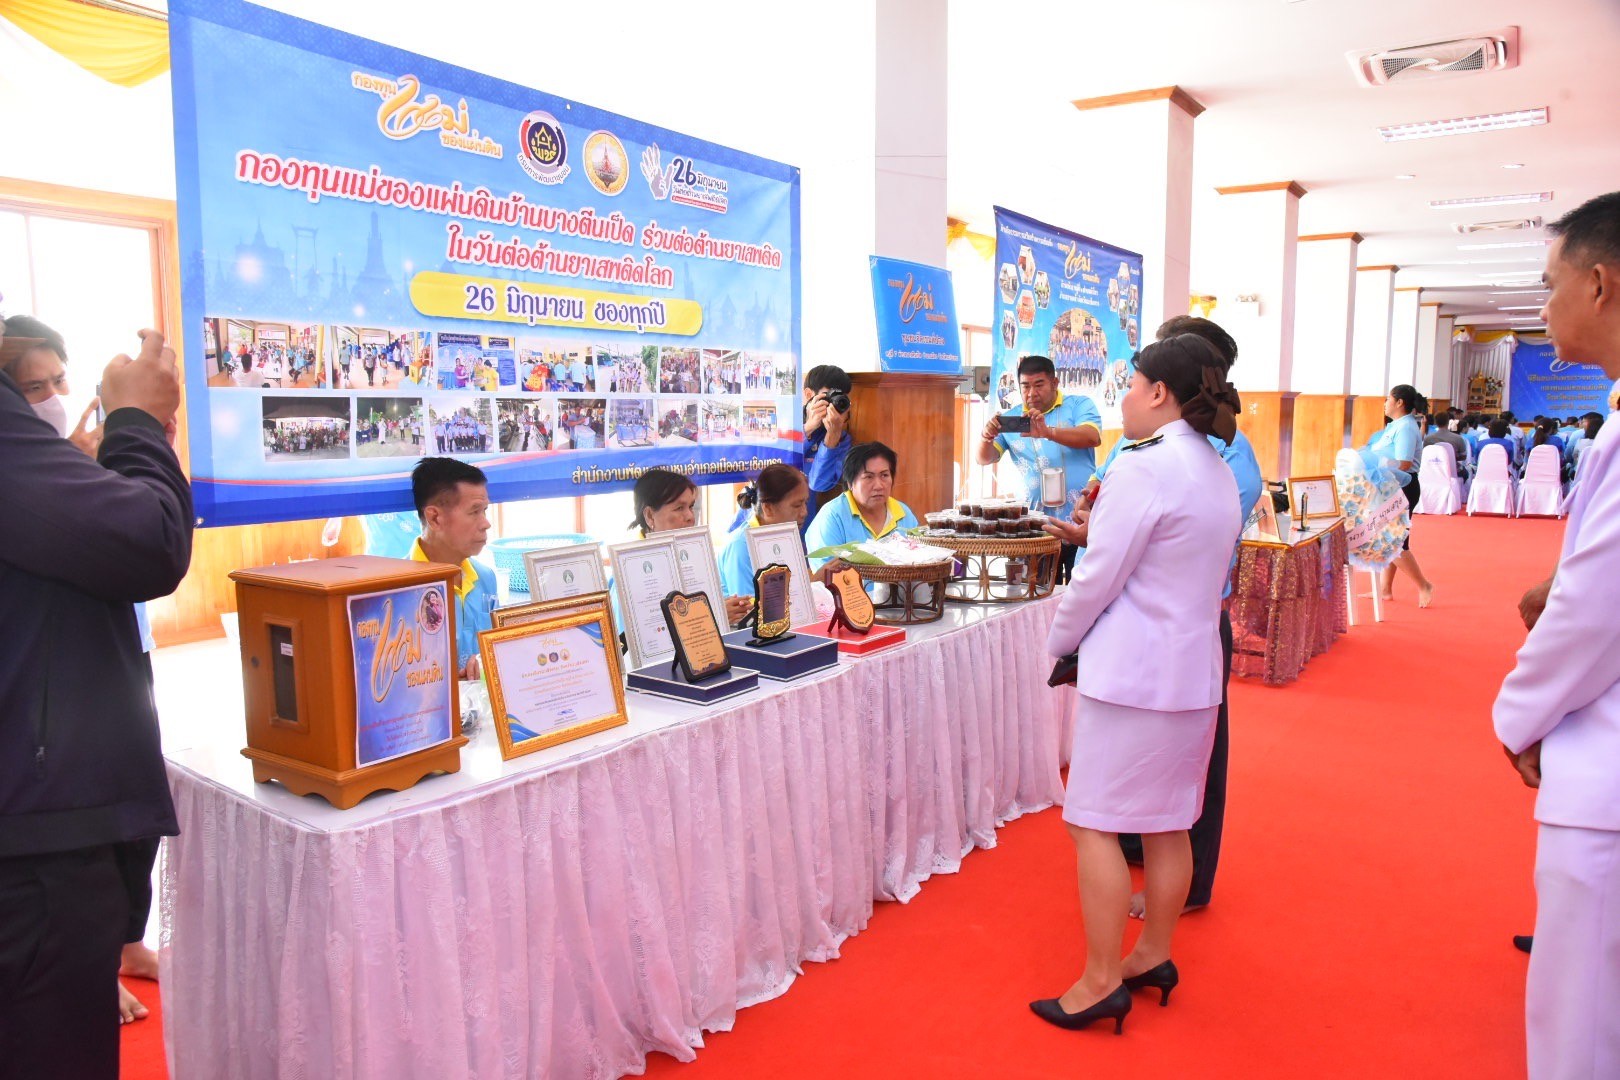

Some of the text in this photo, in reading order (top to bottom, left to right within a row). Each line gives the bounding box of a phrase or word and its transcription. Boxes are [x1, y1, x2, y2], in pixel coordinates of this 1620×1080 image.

[353, 74, 398, 98] กองทุน
[441, 130, 502, 157] ของแผ่นดิน
[673, 158, 728, 192] 26 มิถุนายน
[238, 152, 782, 268] กองทุนแม่ของแผ่นดินบ้านบางตีนเป็ด ร่วมต่อต้านยาเสพติด
[447, 224, 674, 287] ในวันต่อต้านยาเสพติดโลก
[465, 285, 667, 332] 26 มิถุนายน ของทุกปี
